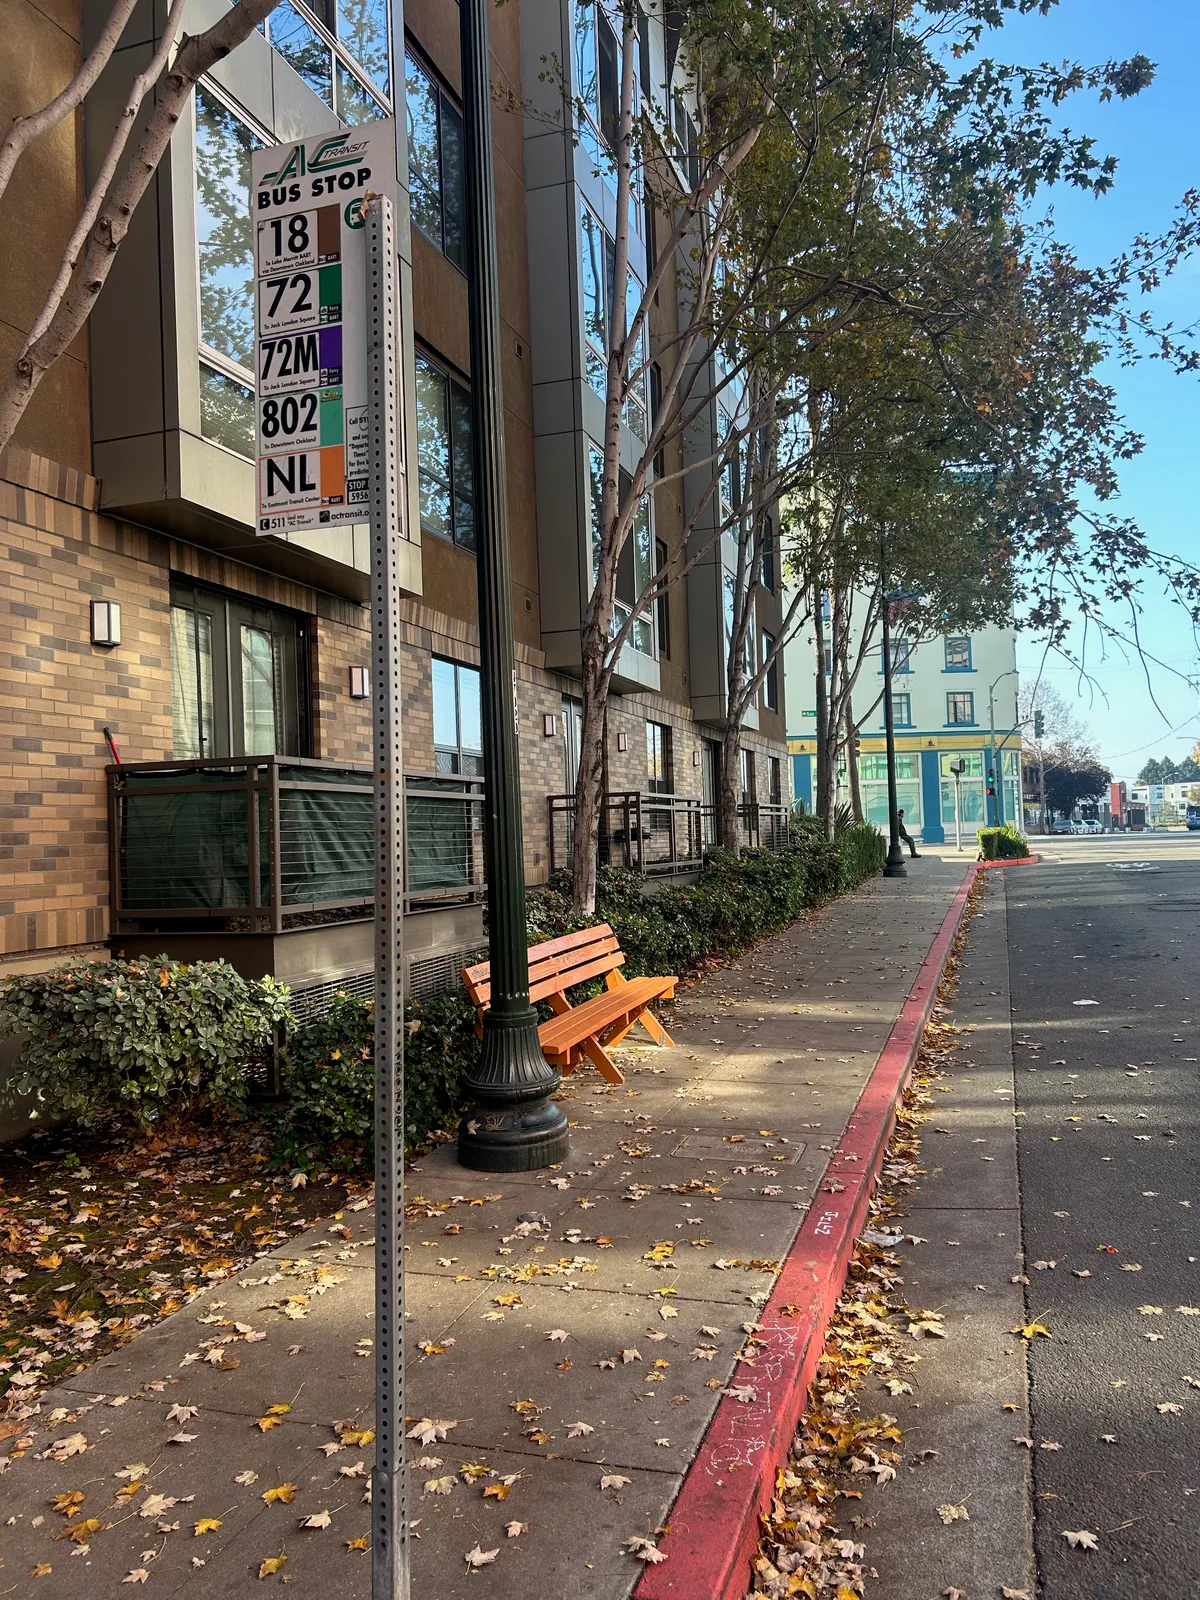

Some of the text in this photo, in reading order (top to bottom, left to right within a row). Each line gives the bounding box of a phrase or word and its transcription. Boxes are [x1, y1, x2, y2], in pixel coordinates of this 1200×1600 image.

[323, 140, 370, 160] TRANSIT
[258, 132, 369, 187] AC
[258, 168, 371, 210] BUS STOP
[271, 214, 309, 257] 18
[270, 264, 294, 272] Downtown
[295, 258, 315, 267] Oakland
[266, 274, 312, 318] 72
[282, 319, 298, 327] London
[262, 334, 318, 380] 72M
[282, 380, 298, 388] London
[299, 377, 316, 385] Square
[262, 394, 318, 438] 802
[270, 440, 294, 449] Downtown
[296, 436, 316, 444] Oakland
[266, 454, 316, 497] NL
[349, 482, 366, 490] STOP
[352, 492, 368, 500] 5956
[271, 517, 285, 528] 511
[331, 509, 369, 520] actransit.o
